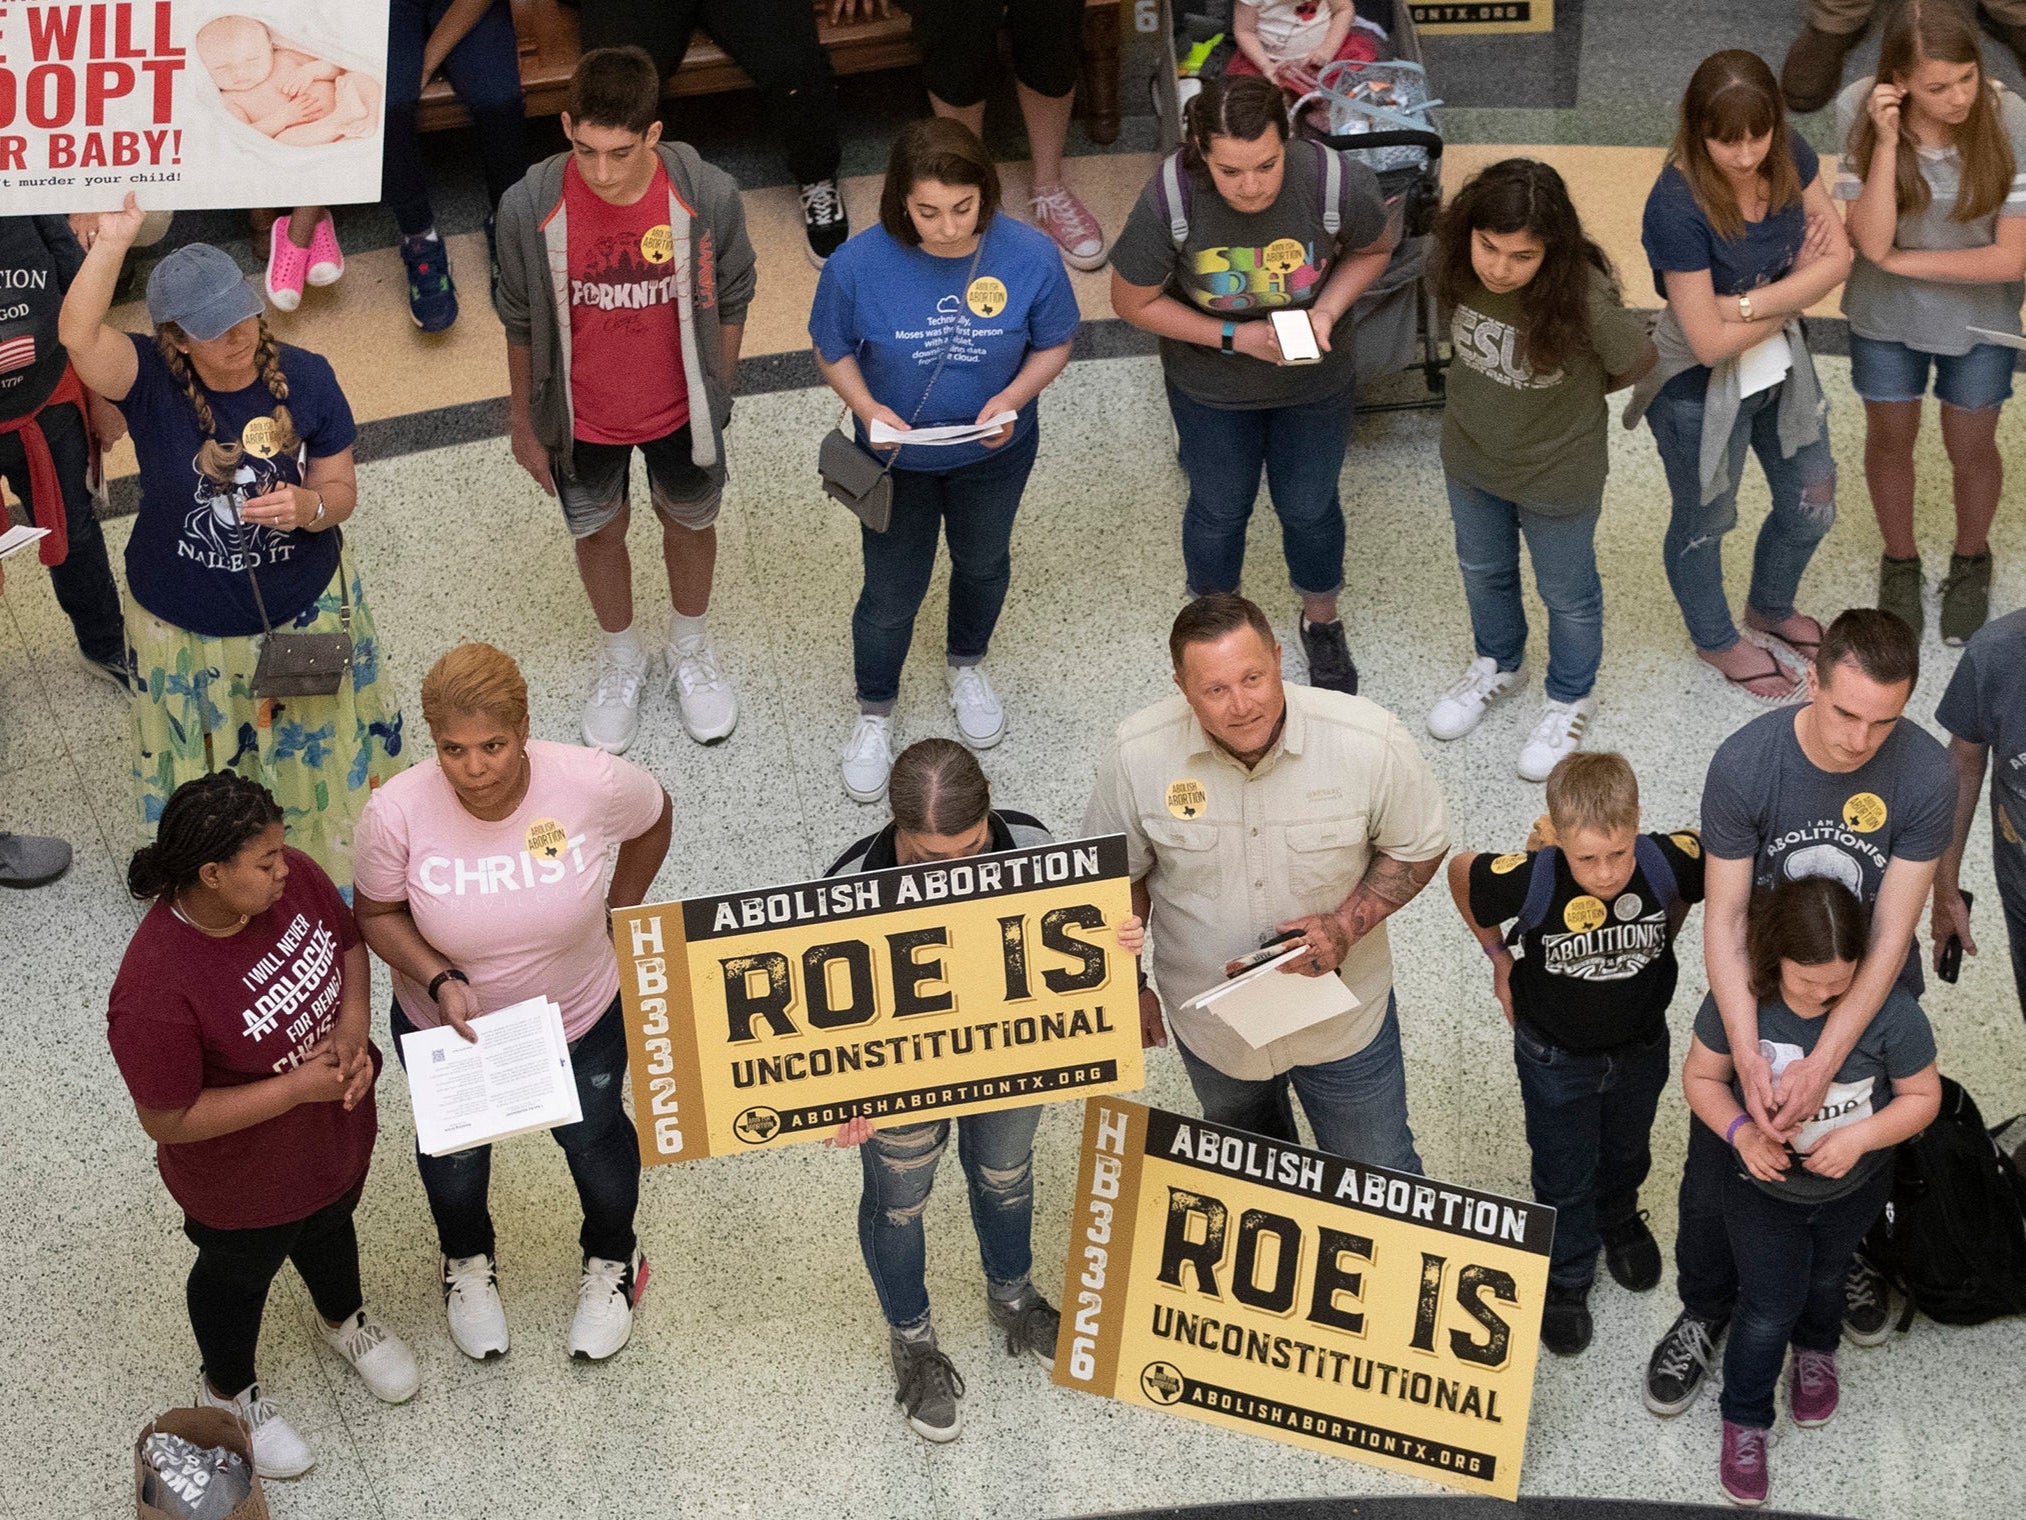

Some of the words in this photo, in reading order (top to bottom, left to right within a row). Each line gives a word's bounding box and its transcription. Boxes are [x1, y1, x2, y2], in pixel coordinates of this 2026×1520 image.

[27, 1, 186, 62] WILL
[49, 129, 183, 169] BABY!
[19, 178, 76, 187] murder
[85, 176, 122, 187] your
[130, 172, 181, 183] child!
[895, 330, 924, 340] Moses
[925, 329, 942, 337] was
[972, 328, 1003, 338] person
[268, 545, 295, 563] IT
[1168, 791, 1206, 807] ABORTION
[1172, 782, 1198, 794] ABOLISH
[528, 828, 566, 850] ABORTION
[531, 821, 556, 836] ABOLISH
[1817, 819, 1834, 827] AM
[419, 833, 586, 895] CHRIST
[1767, 827, 1888, 874] ABOLITIONIS
[712, 879, 881, 932] ABOLISH
[896, 846, 1100, 905] ABORTION
[276, 913, 311, 957] NEVER
[242, 977, 256, 992] I
[248, 952, 285, 985] WILL
[718, 926, 957, 1043] ROE
[996, 904, 1109, 1002] IS
[286, 1011, 313, 1043] FOR
[628, 916, 684, 1155] HB3326
[730, 1006, 1114, 1090] UNCONSTITUTIONAL
[791, 1067, 1102, 1127] ABOLISHABORTIONTX.ORG
[1170, 1124, 1325, 1192] ABOLISH
[1334, 1168, 1528, 1243] ABORTION
[1069, 1108, 1130, 1381] HB3326
[1156, 1185, 1377, 1334] ROE
[1408, 1252, 1520, 1368] IS
[1152, 1304, 1503, 1424] UNCONSTITUTIONAL
[1192, 1388, 1482, 1473] ABOLISHABORTIONTX.ORG
